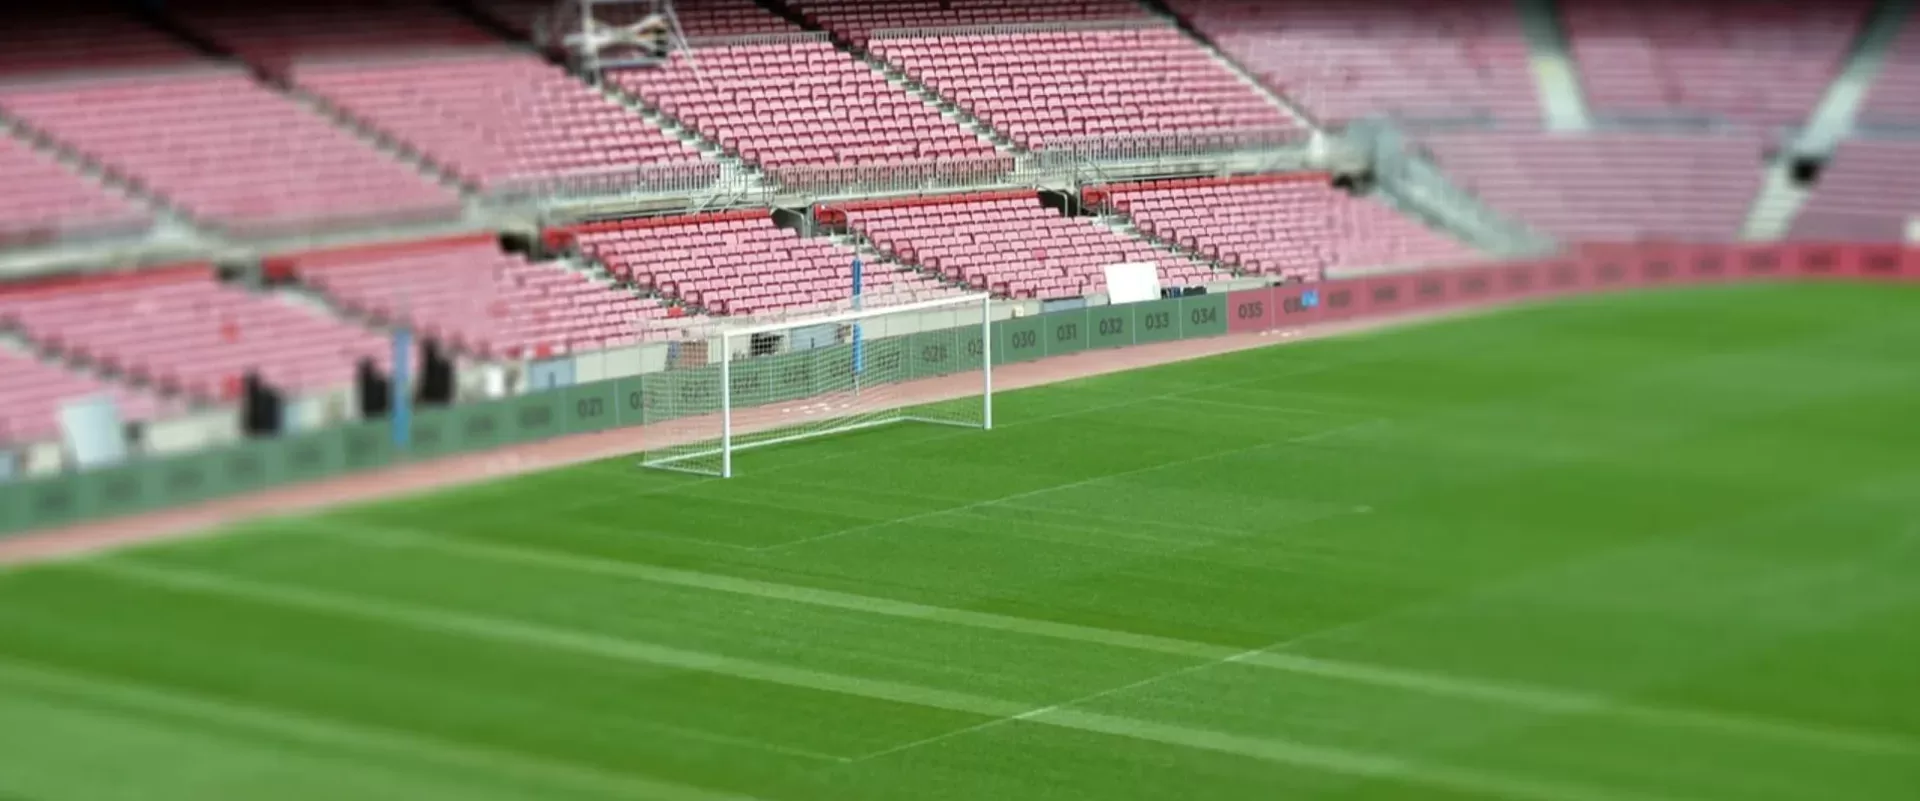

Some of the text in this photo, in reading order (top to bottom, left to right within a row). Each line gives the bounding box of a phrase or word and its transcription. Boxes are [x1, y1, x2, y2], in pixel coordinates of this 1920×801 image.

[1191, 307, 1216, 325] 034
[1238, 301, 1263, 319] 035
[1099, 317, 1123, 336] 032
[1145, 312, 1169, 330] 033
[1012, 329, 1036, 349] 030
[1056, 323, 1077, 342] 031
[967, 337, 984, 356] 02
[577, 397, 604, 418] 021
